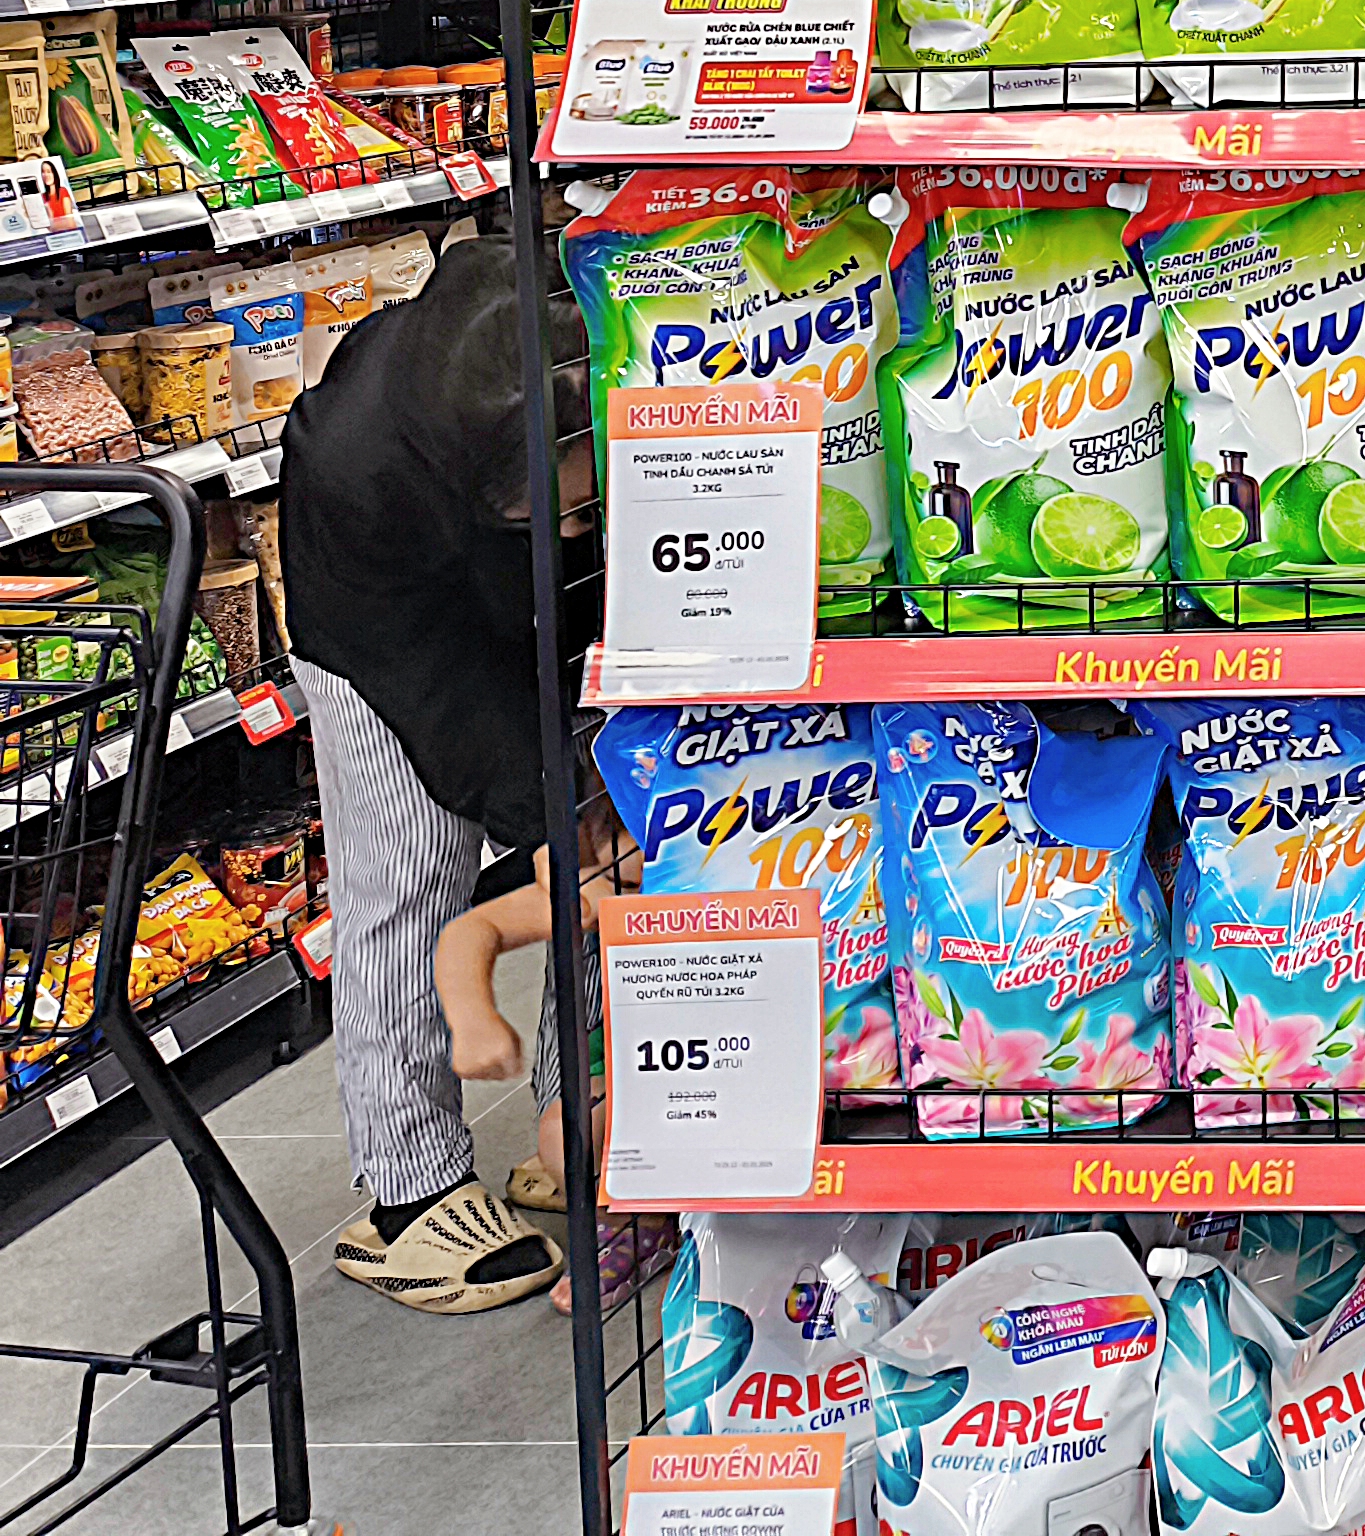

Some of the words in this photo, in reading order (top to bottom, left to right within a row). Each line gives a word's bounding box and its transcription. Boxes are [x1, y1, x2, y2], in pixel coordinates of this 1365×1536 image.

[689, 116, 739, 130] 59.000
[629, 394, 740, 429] KHUYẾN
[748, 393, 799, 423] MÃI
[634, 453, 691, 464] POWER100
[736, 450, 758, 459] LAU
[761, 447, 783, 458] SÀN
[652, 533, 711, 573] 65
[715, 530, 765, 551] .000
[626, 901, 740, 935] KHUYẾN
[748, 900, 798, 930] MÃI
[637, 1040, 710, 1072] 105
[714, 1037, 750, 1052] .000
[695, 1110, 717, 1119] 45%
[942, 1385, 1103, 1447] ARIEL
